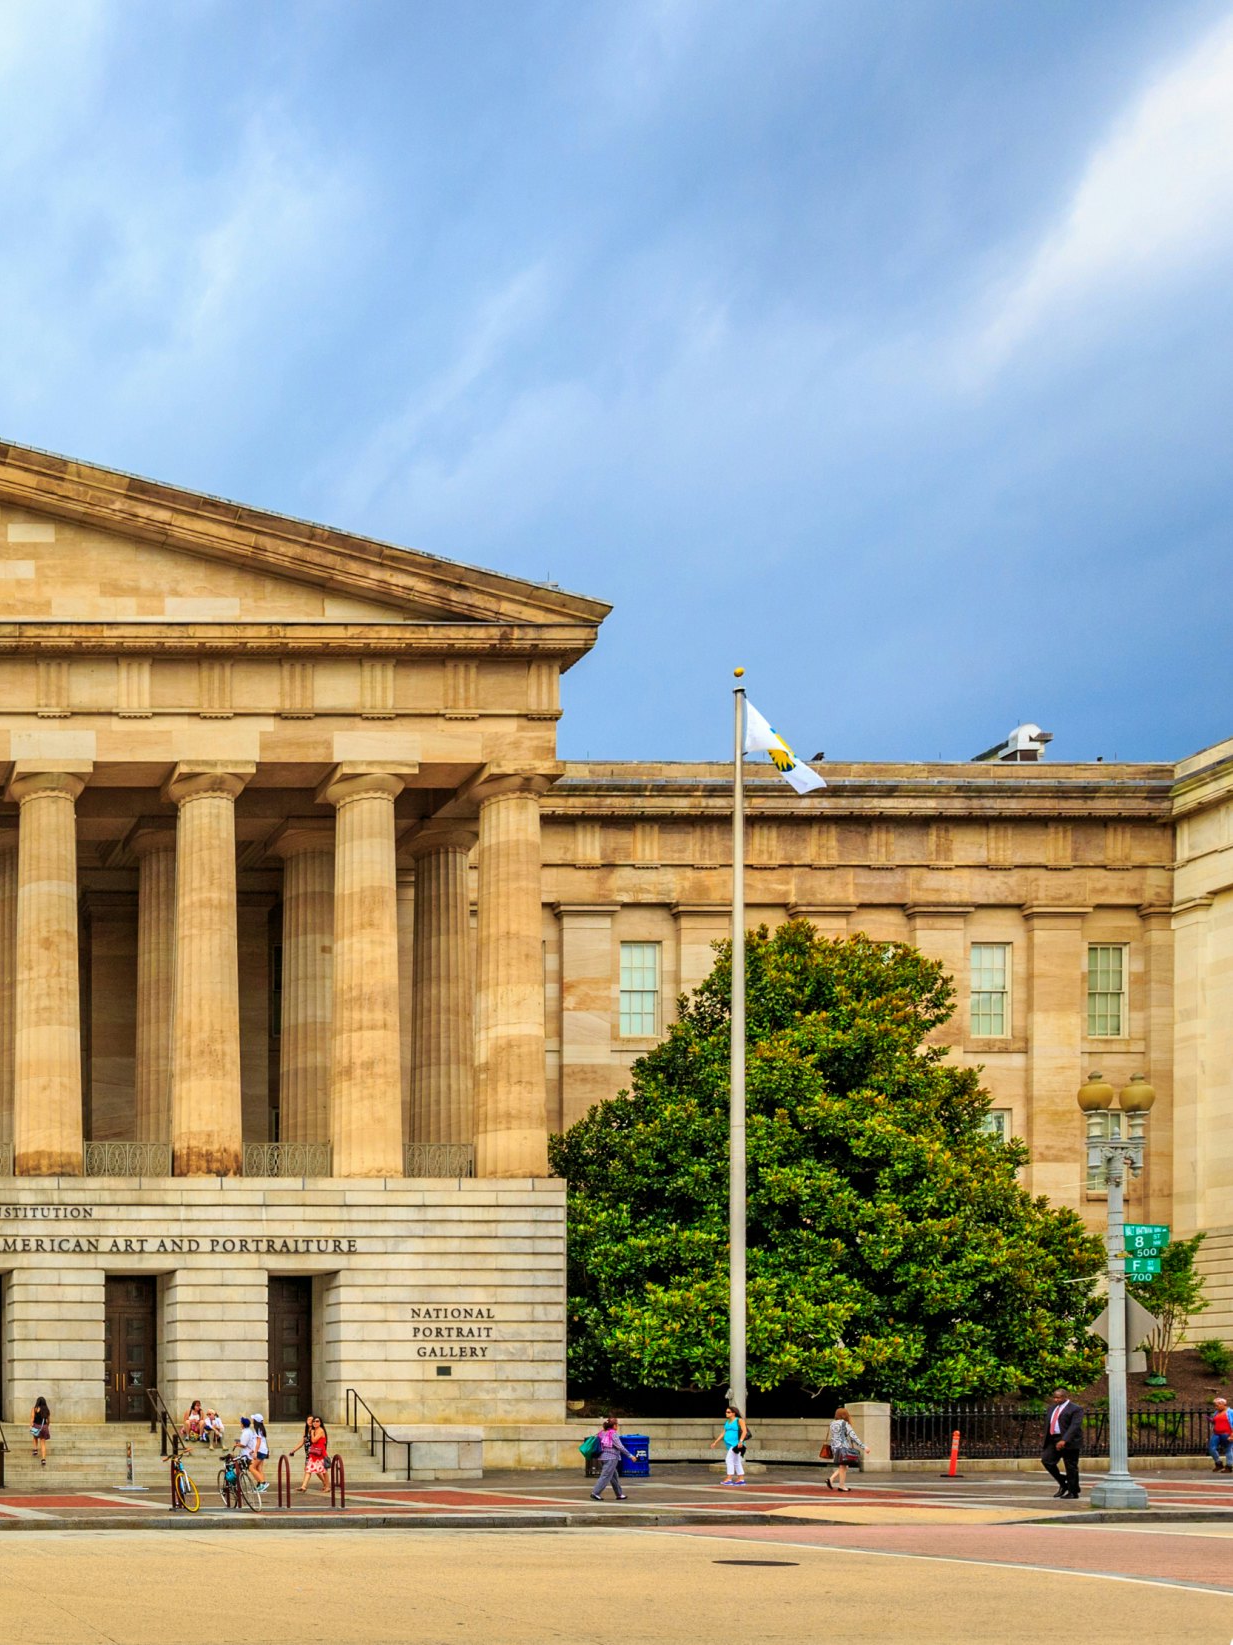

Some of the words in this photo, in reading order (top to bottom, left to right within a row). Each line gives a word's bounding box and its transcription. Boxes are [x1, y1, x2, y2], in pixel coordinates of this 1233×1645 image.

[109, 1239, 148, 1252] ART
[156, 1239, 200, 1252] AND
[210, 1239, 358, 1252] PORTRAITURE
[1135, 1235, 1144, 1248] 8
[1137, 1248, 1157, 1257] 500
[1133, 1260, 1141, 1271] F
[1132, 1273, 1152, 1281] 700
[411, 1308, 495, 1319] NATIONAL
[413, 1327, 493, 1338] PORTRAIT
[417, 1347, 488, 1358] GALLERY
